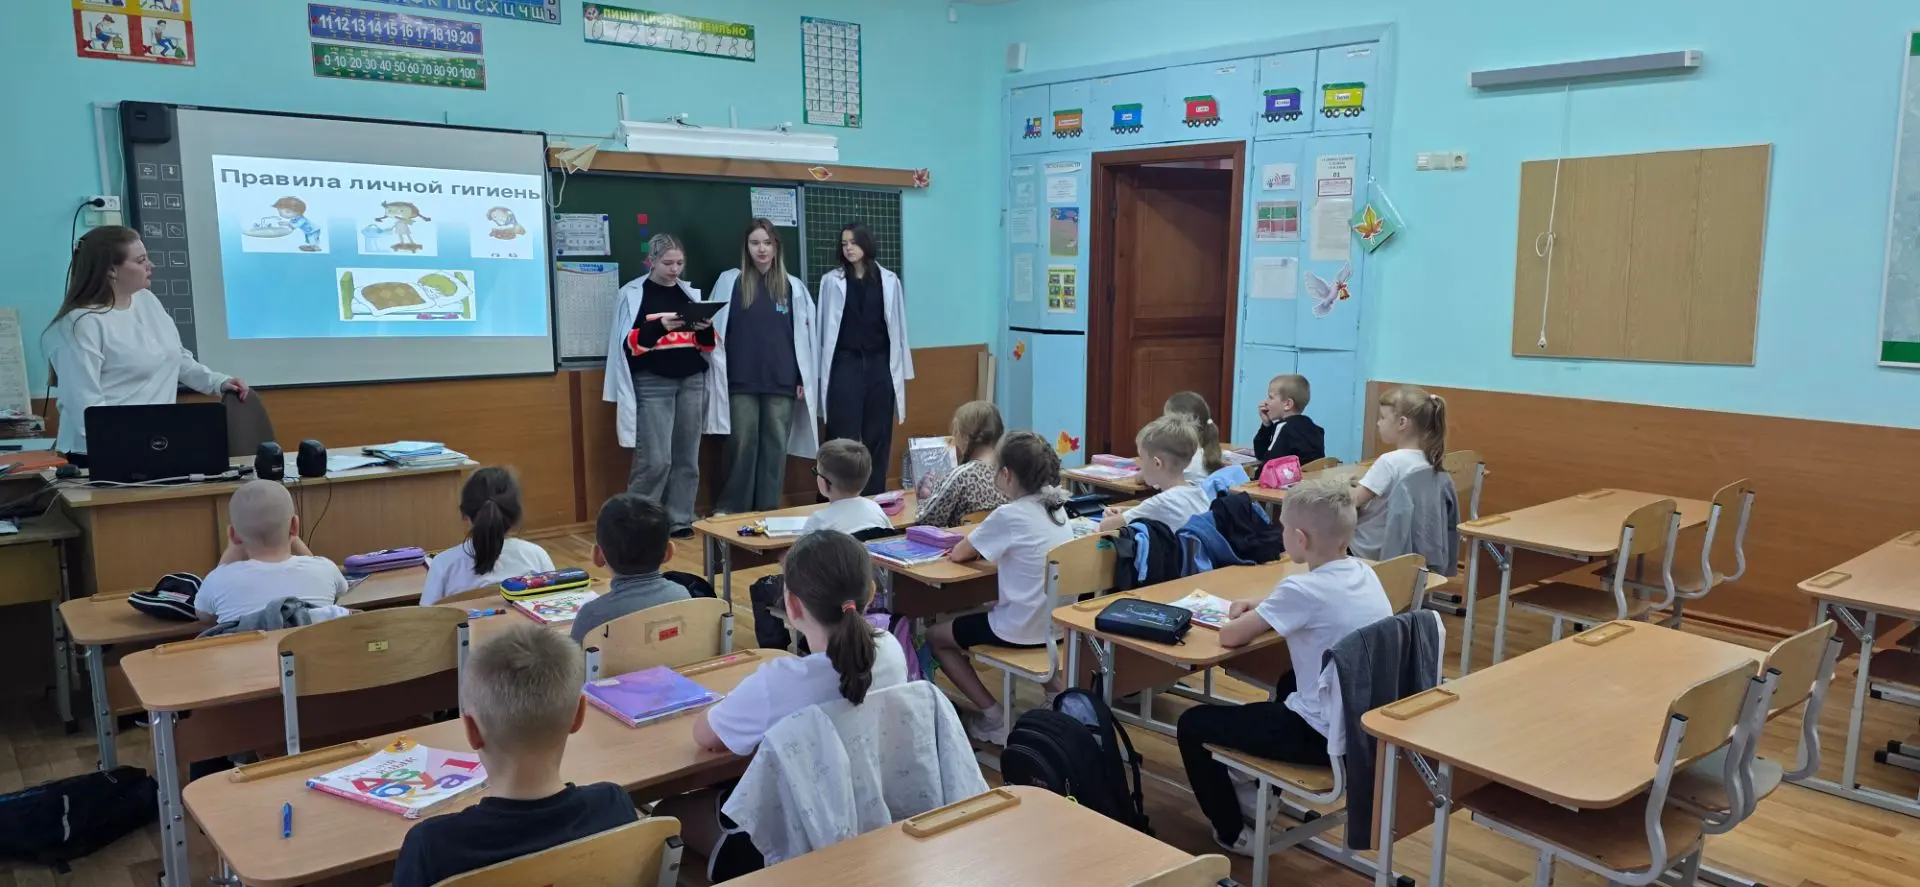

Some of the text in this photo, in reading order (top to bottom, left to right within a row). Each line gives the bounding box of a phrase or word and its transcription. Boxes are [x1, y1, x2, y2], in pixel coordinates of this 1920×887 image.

[475, 0, 485, 12] С
[487, 1, 500, 14] Х
[504, 3, 516, 17] Ц
[519, 5, 528, 17] Ч
[531, 6, 544, 20] Щ
[603, 8, 747, 37] ПИШИ ЦИФРЫ ПРАВИЛЬНО
[320, 14, 474, 44] 11 12 13 14 15 16 17 18 19 20
[591, 20, 754, 59] 0 1 2 3 4 5 6 7 8 9
[324, 54, 476, 79] 0 10 20 30 40 50 60 70 80 90 100
[220, 168, 342, 189] Правила
[349, 178, 443, 195] личной
